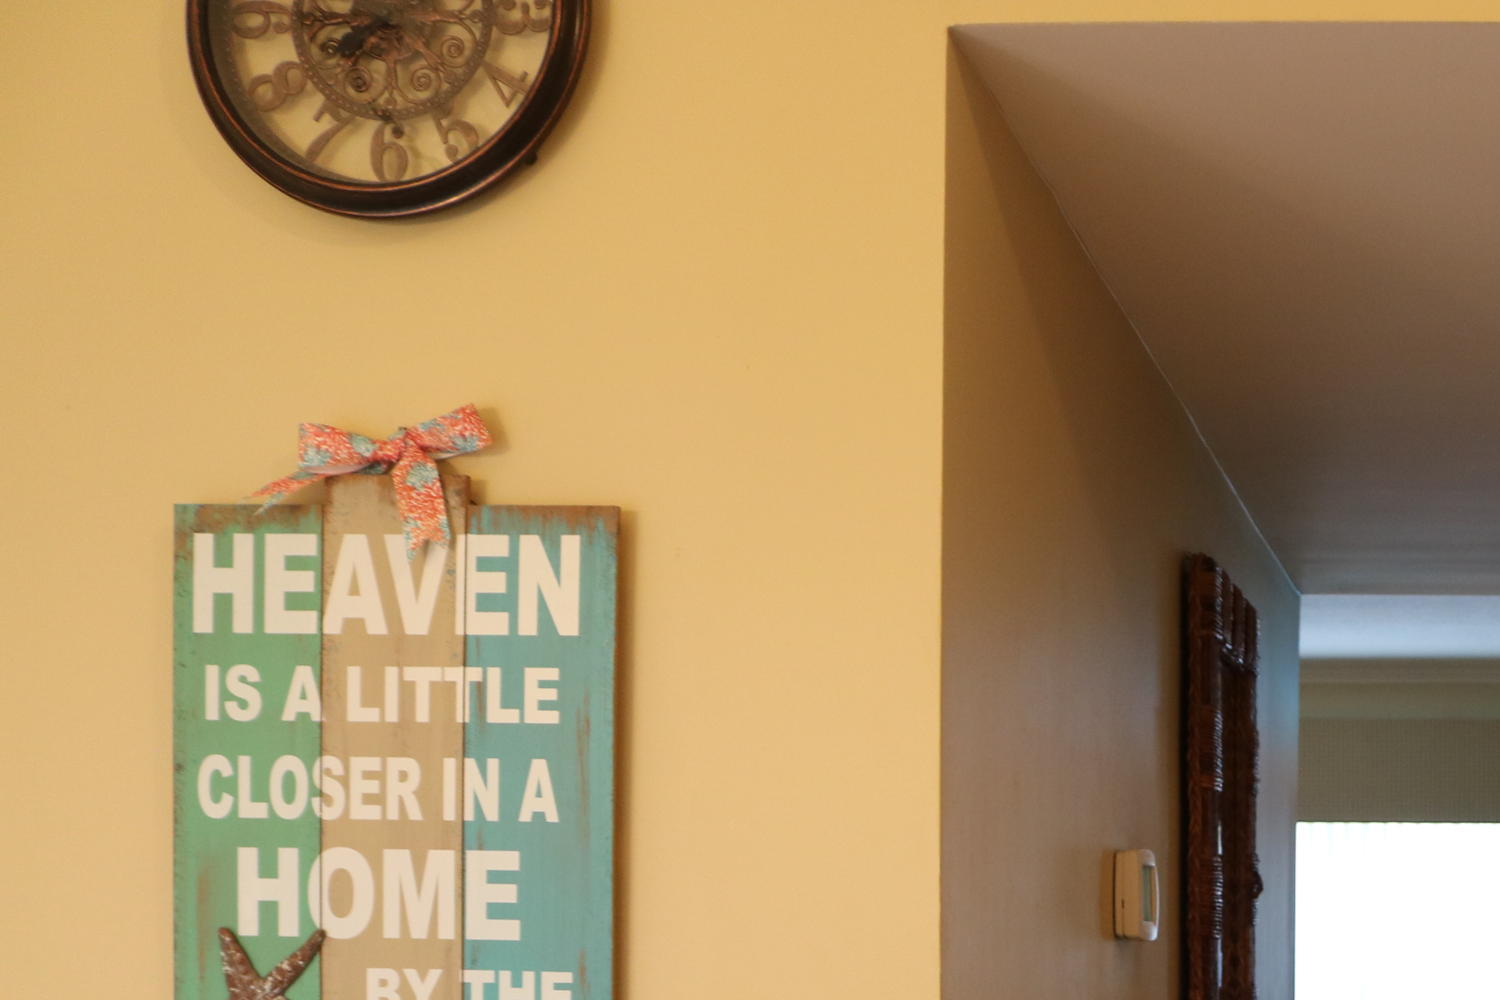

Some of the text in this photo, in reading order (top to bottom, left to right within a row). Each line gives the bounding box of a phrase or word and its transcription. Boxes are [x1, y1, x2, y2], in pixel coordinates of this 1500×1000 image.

[248, 61, 308, 113] 8
[482, 60, 530, 108] 4
[305, 98, 356, 163] 7
[370, 118, 409, 182] 6
[432, 104, 480, 163] 5
[193, 533, 581, 636] HEAVEN
[205, 664, 560, 724] IS A LITTLE
[197, 754, 560, 823] CLOSER IN A
[236, 846, 521, 941] HOME
